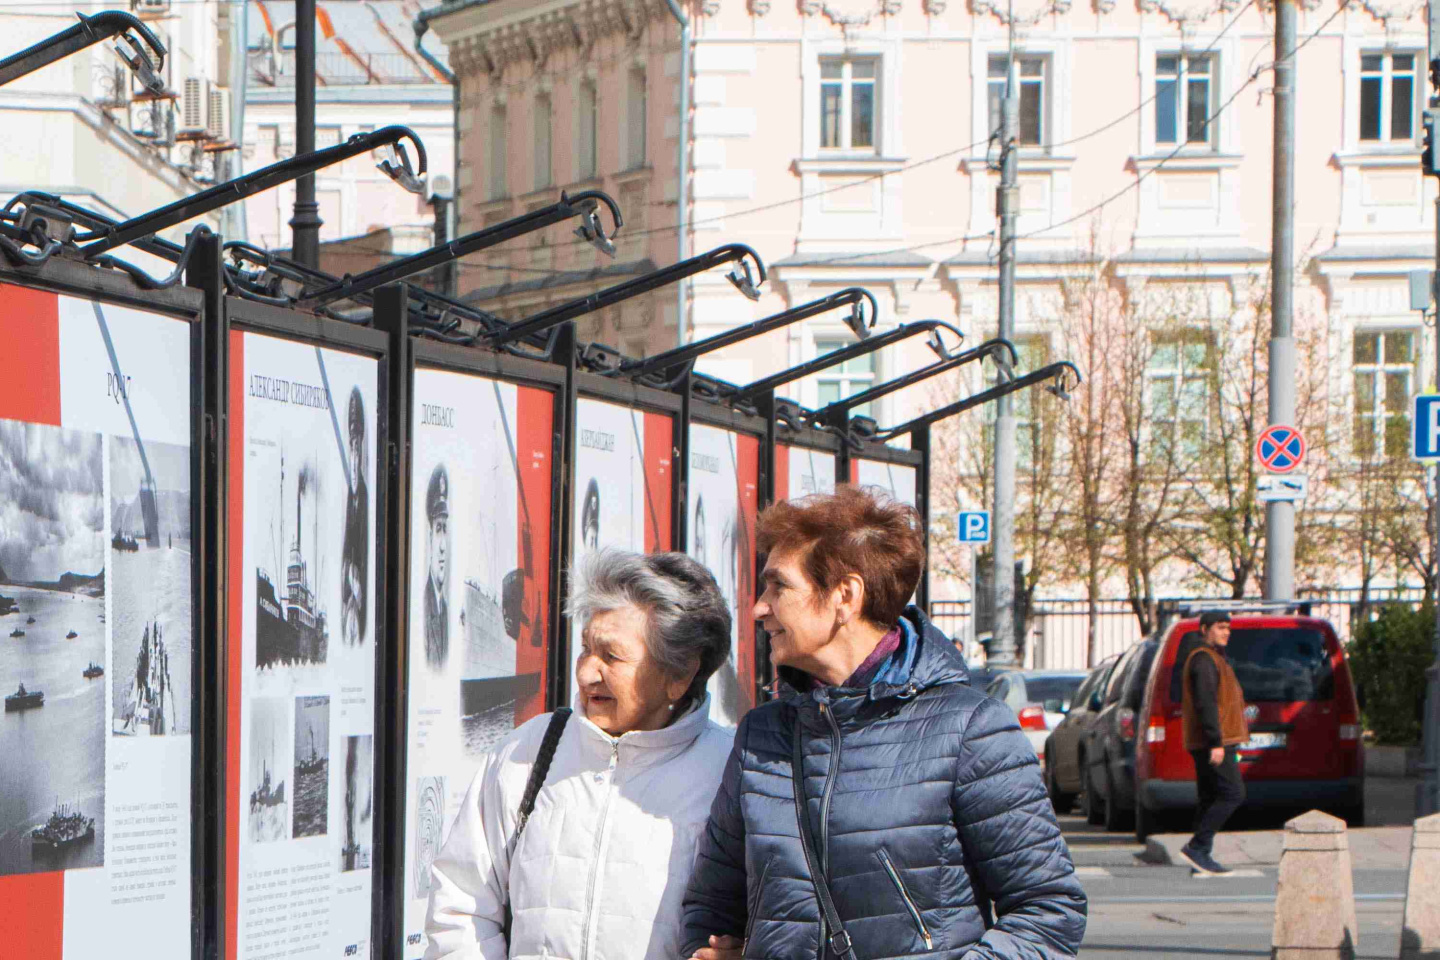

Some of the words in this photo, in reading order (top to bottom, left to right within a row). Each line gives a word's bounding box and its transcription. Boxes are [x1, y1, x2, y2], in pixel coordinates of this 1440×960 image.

[249, 374, 289, 405] АЛЕКСАНДР
[291, 381, 329, 409] СИБИРЯКОВ
[421, 403, 454, 428] ДОНБАСС
[966, 514, 985, 540] P
